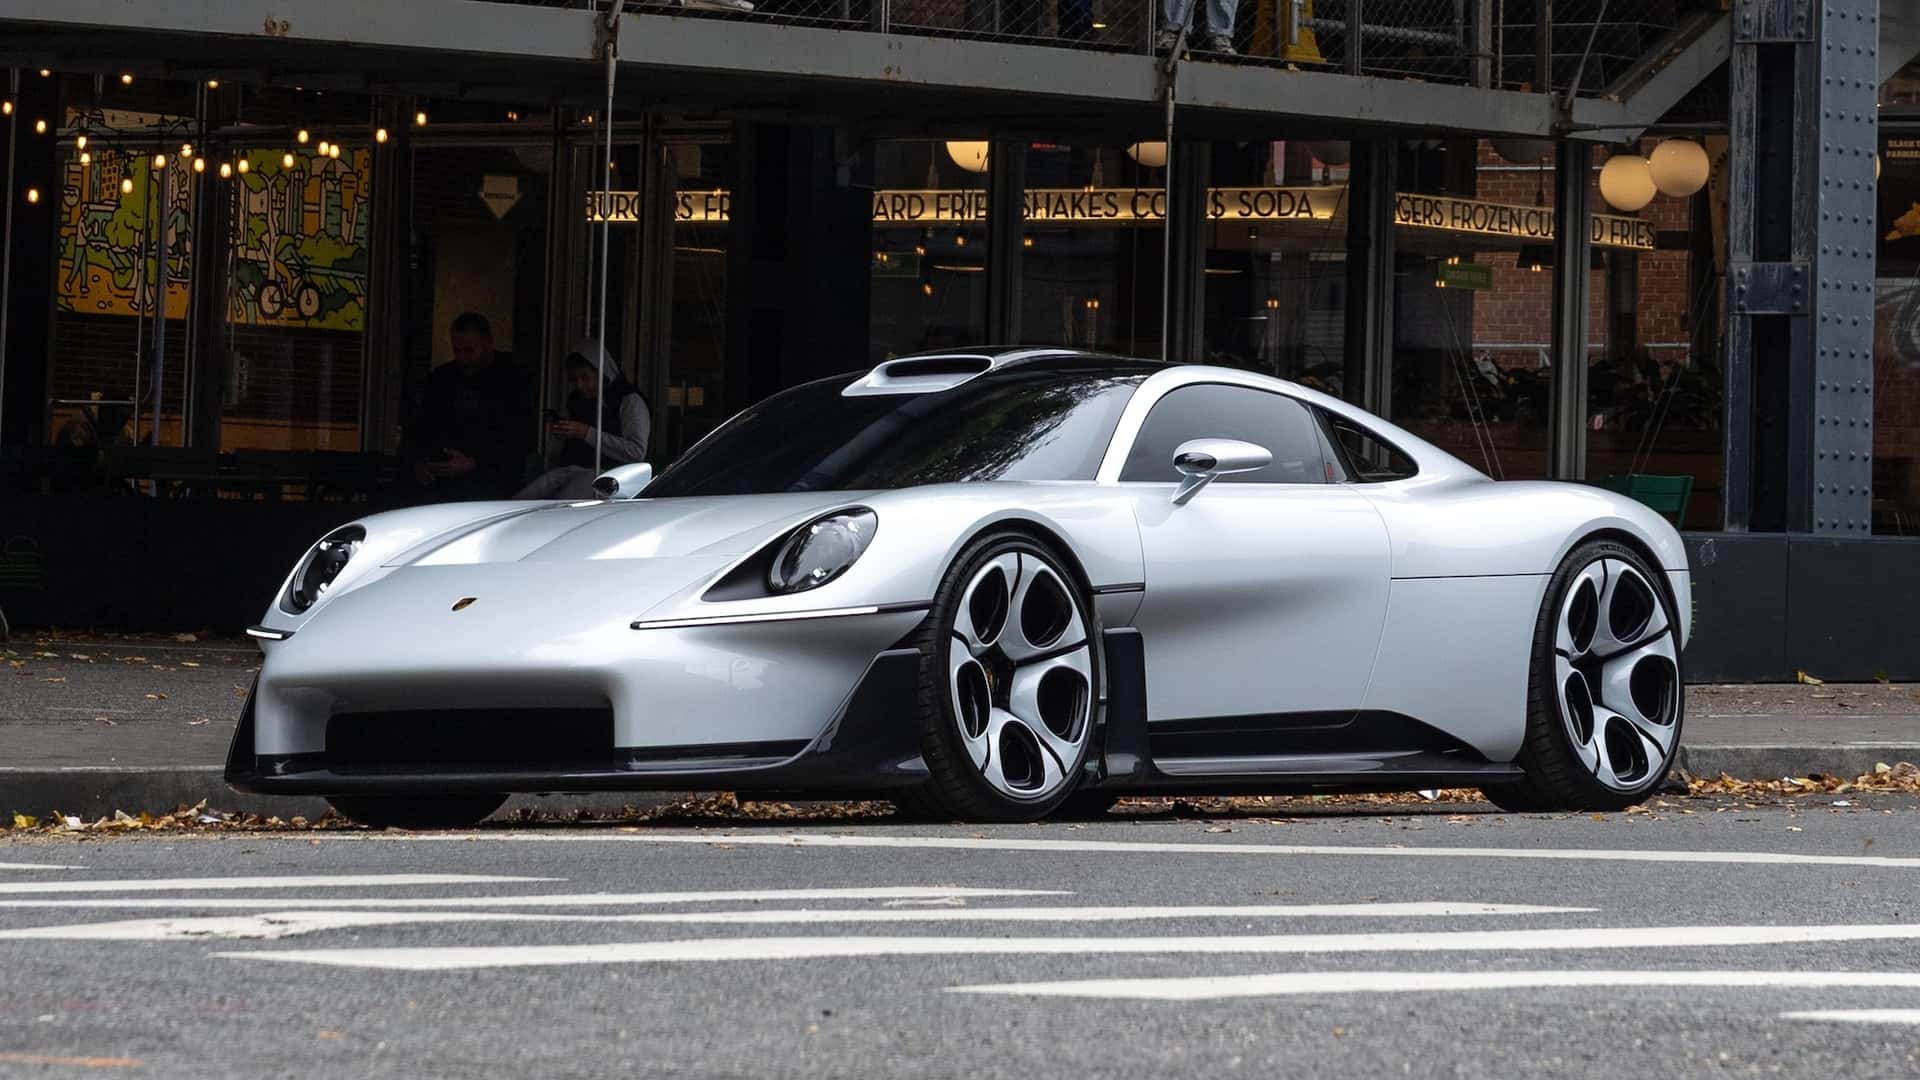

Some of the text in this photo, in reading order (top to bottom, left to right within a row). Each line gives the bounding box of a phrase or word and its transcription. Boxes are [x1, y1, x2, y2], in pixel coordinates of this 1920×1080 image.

[936, 194, 987, 219] FRIE
[1238, 190, 1313, 217] SODA
[1396, 195, 1444, 226] GERS
[1451, 201, 1522, 234] FROZEN
[1610, 219, 1656, 247] FRIES
